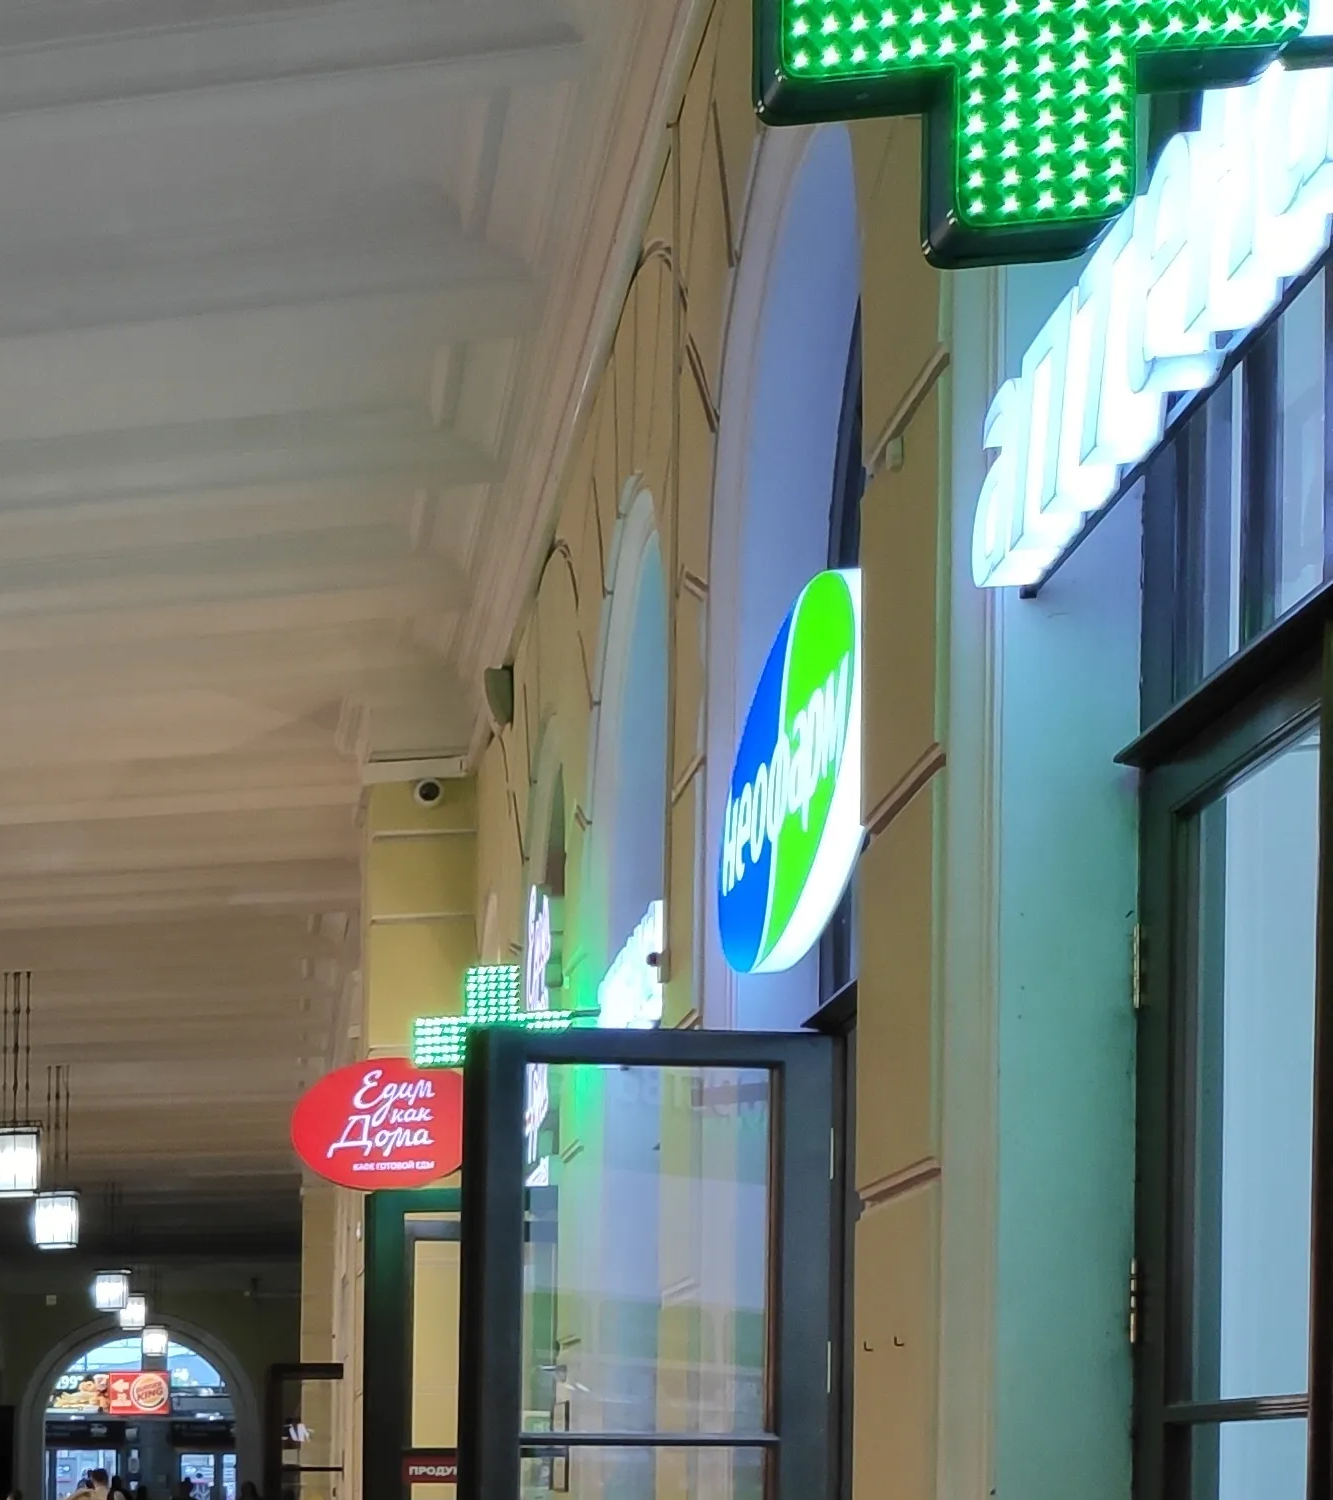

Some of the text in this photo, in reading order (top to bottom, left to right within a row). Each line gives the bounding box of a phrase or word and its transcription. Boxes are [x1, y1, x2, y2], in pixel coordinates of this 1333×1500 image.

[353, 1069, 435, 1127] Едим
[390, 1106, 435, 1124] как
[326, 1114, 435, 1158] Дома
[136, 1387, 164, 1400] KING
